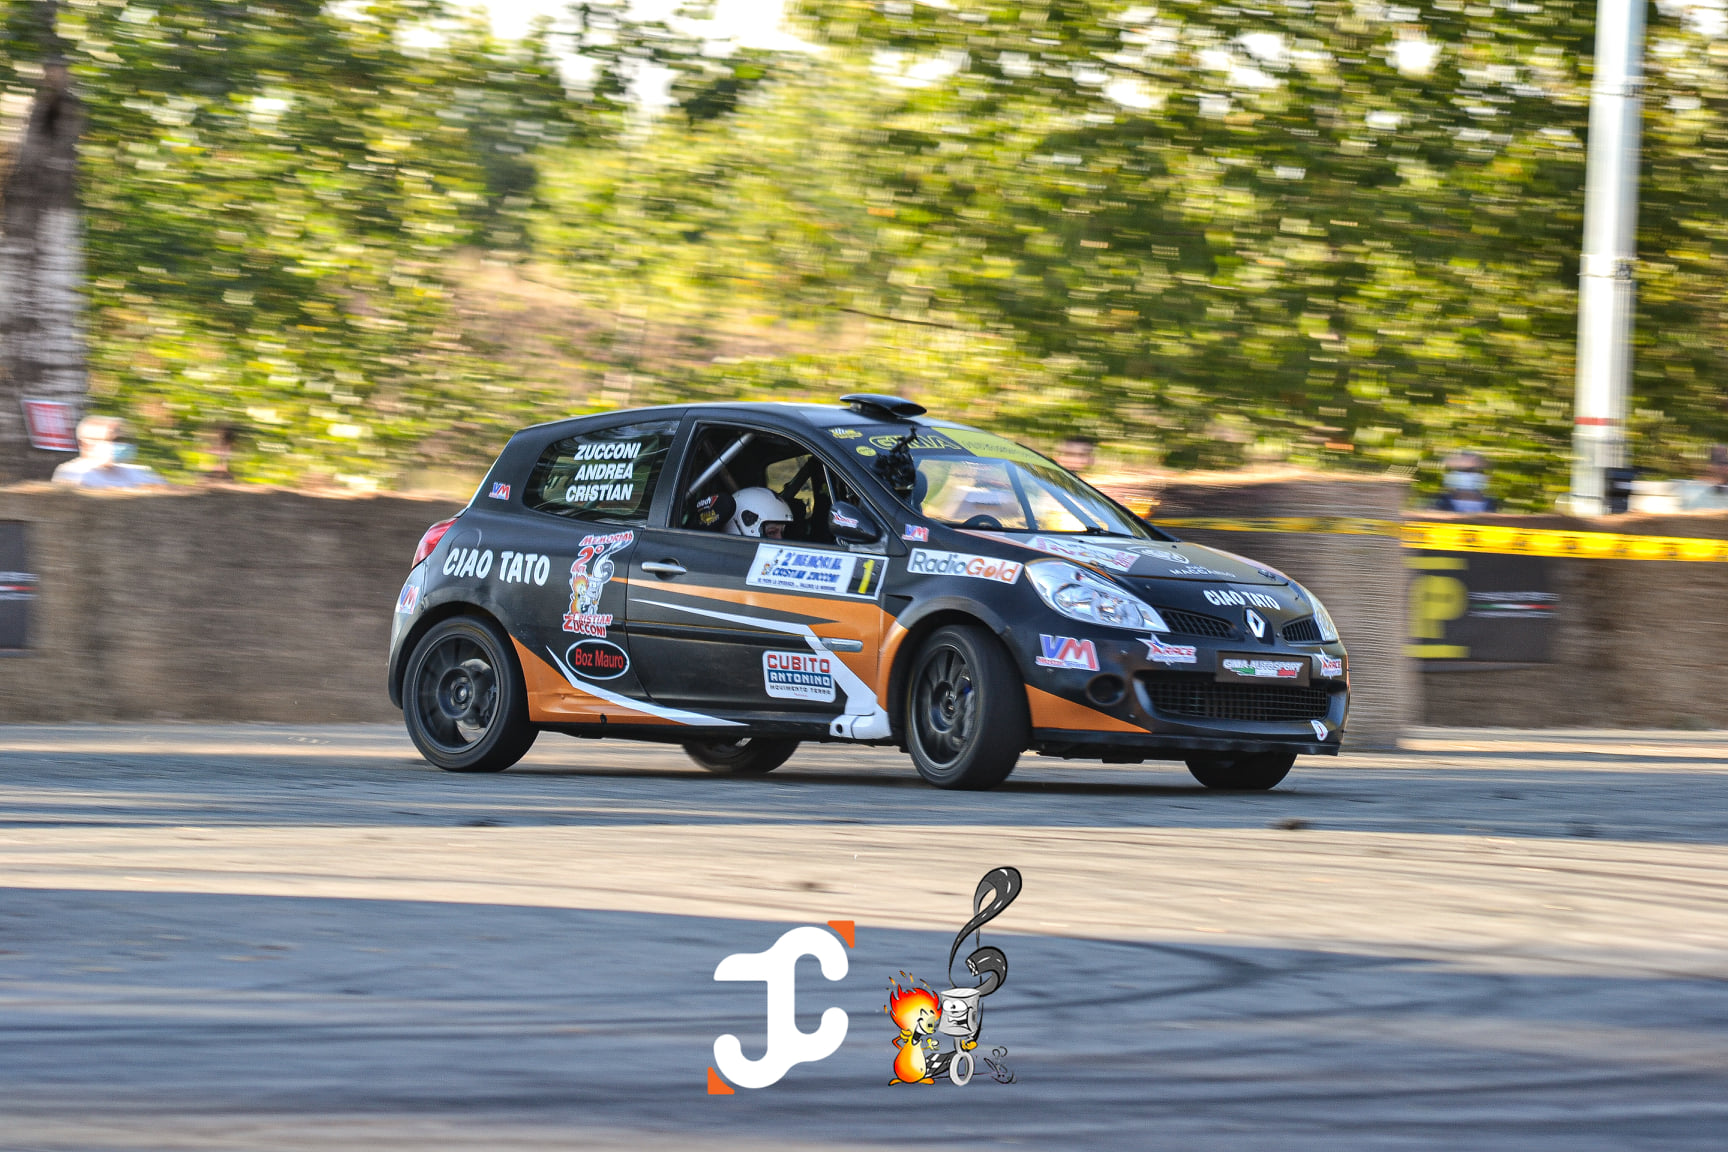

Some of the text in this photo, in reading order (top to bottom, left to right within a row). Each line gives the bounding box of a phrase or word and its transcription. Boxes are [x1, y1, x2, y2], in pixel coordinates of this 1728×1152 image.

[573, 442, 641, 461] ZUCCONI
[574, 462, 634, 480] ANDREA
[492, 482, 511, 500] VM
[565, 483, 634, 503] CRISTIAN
[581, 531, 632, 545] MEMORIAL
[442, 547, 551, 587] CIAO TATO
[857, 559, 875, 594] 1
[911, 551, 1020, 582] RadioGold
[1203, 590, 1281, 610] CIAO TATO
[575, 648, 624, 669] Boz Mauro
[1041, 636, 1098, 670] VM
[1163, 647, 1194, 657] RACE
[767, 654, 831, 674] CUBITO
[770, 671, 831, 686] ANTONINO
